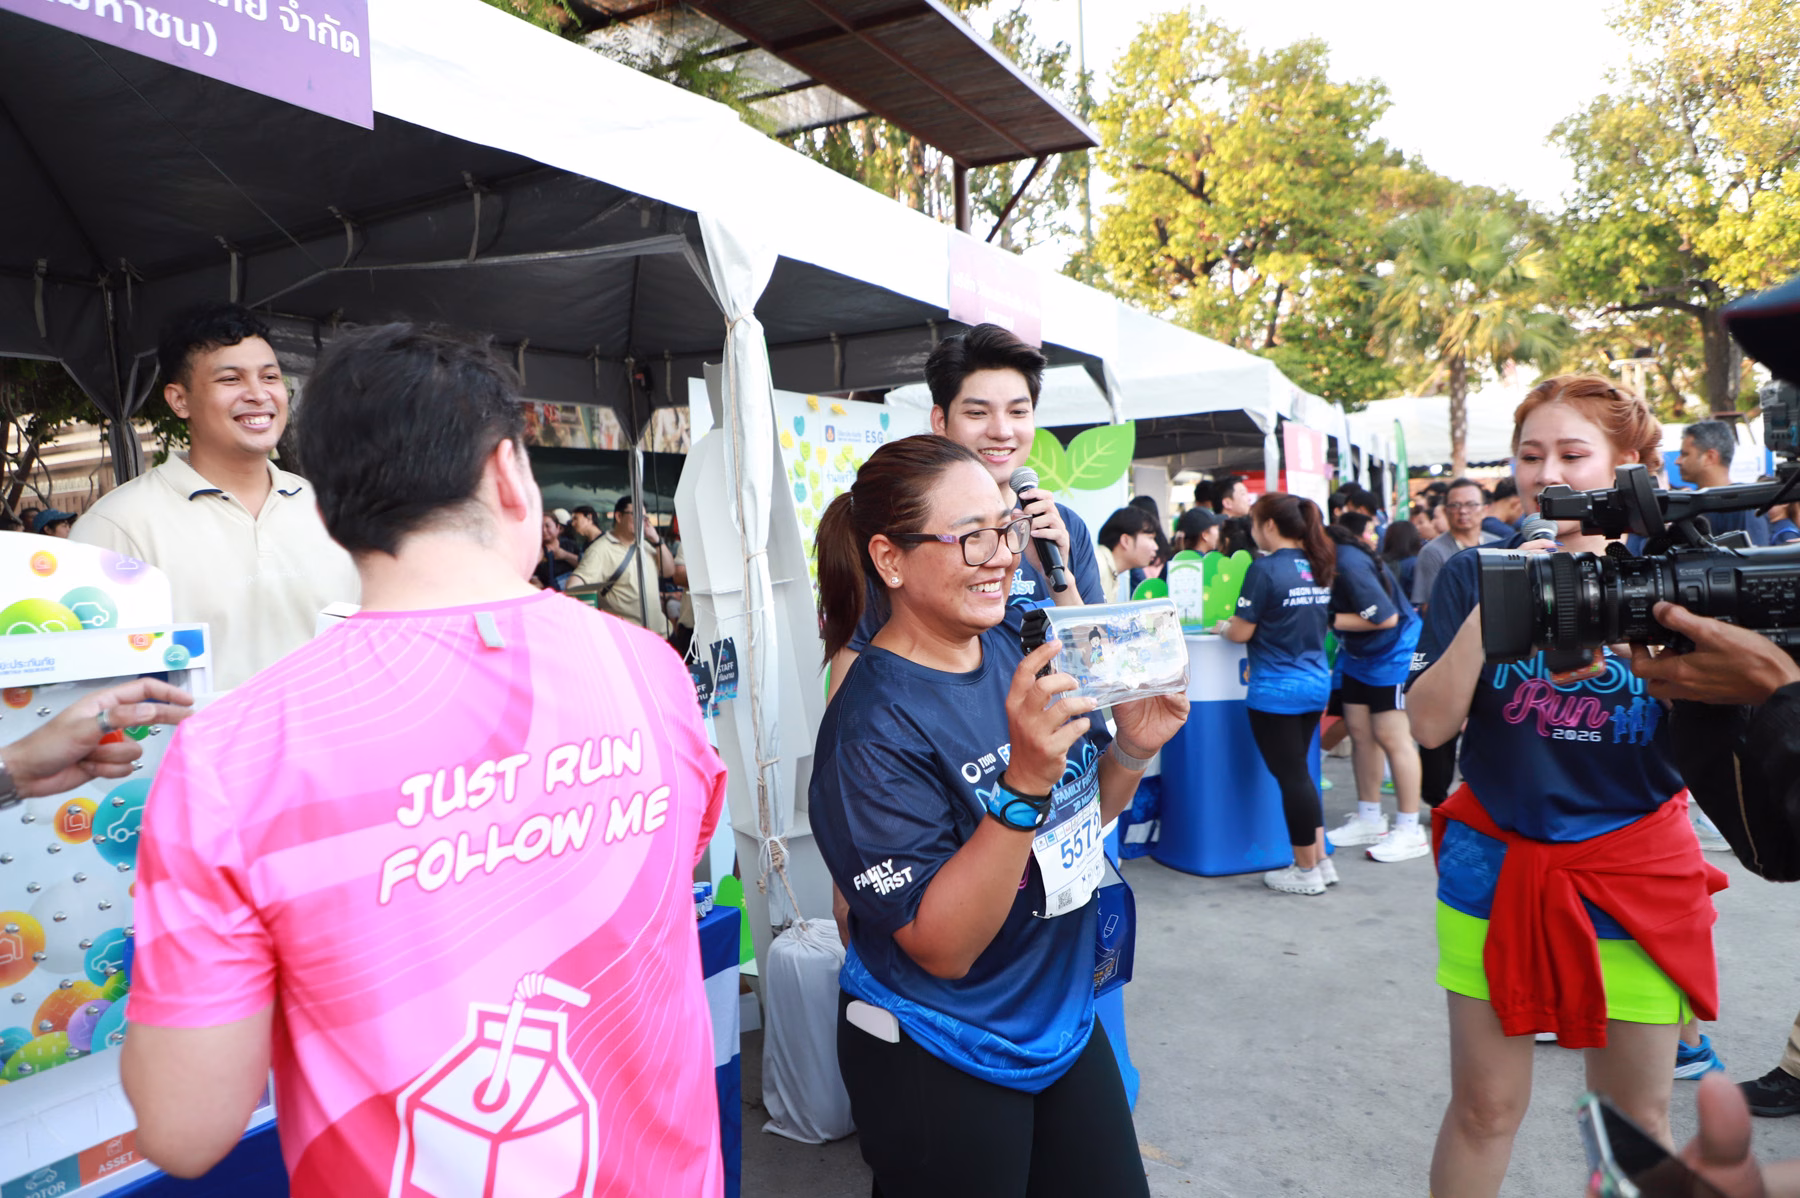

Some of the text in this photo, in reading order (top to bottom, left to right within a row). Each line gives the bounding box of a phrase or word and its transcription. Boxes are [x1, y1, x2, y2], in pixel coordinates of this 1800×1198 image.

[46, 0, 218, 57] หาชน)
[279, 0, 360, 58] จำกัด
[865, 429, 884, 444] ESG
[1503, 678, 1610, 737] Run
[1552, 728, 1602, 742] 2026
[397, 728, 642, 828] JUST RUN
[1054, 780, 1081, 805] FAMILY
[378, 785, 671, 906] FOLLOW ME
[1061, 811, 1101, 869] 5572
[98, 1151, 134, 1175] ASSET
